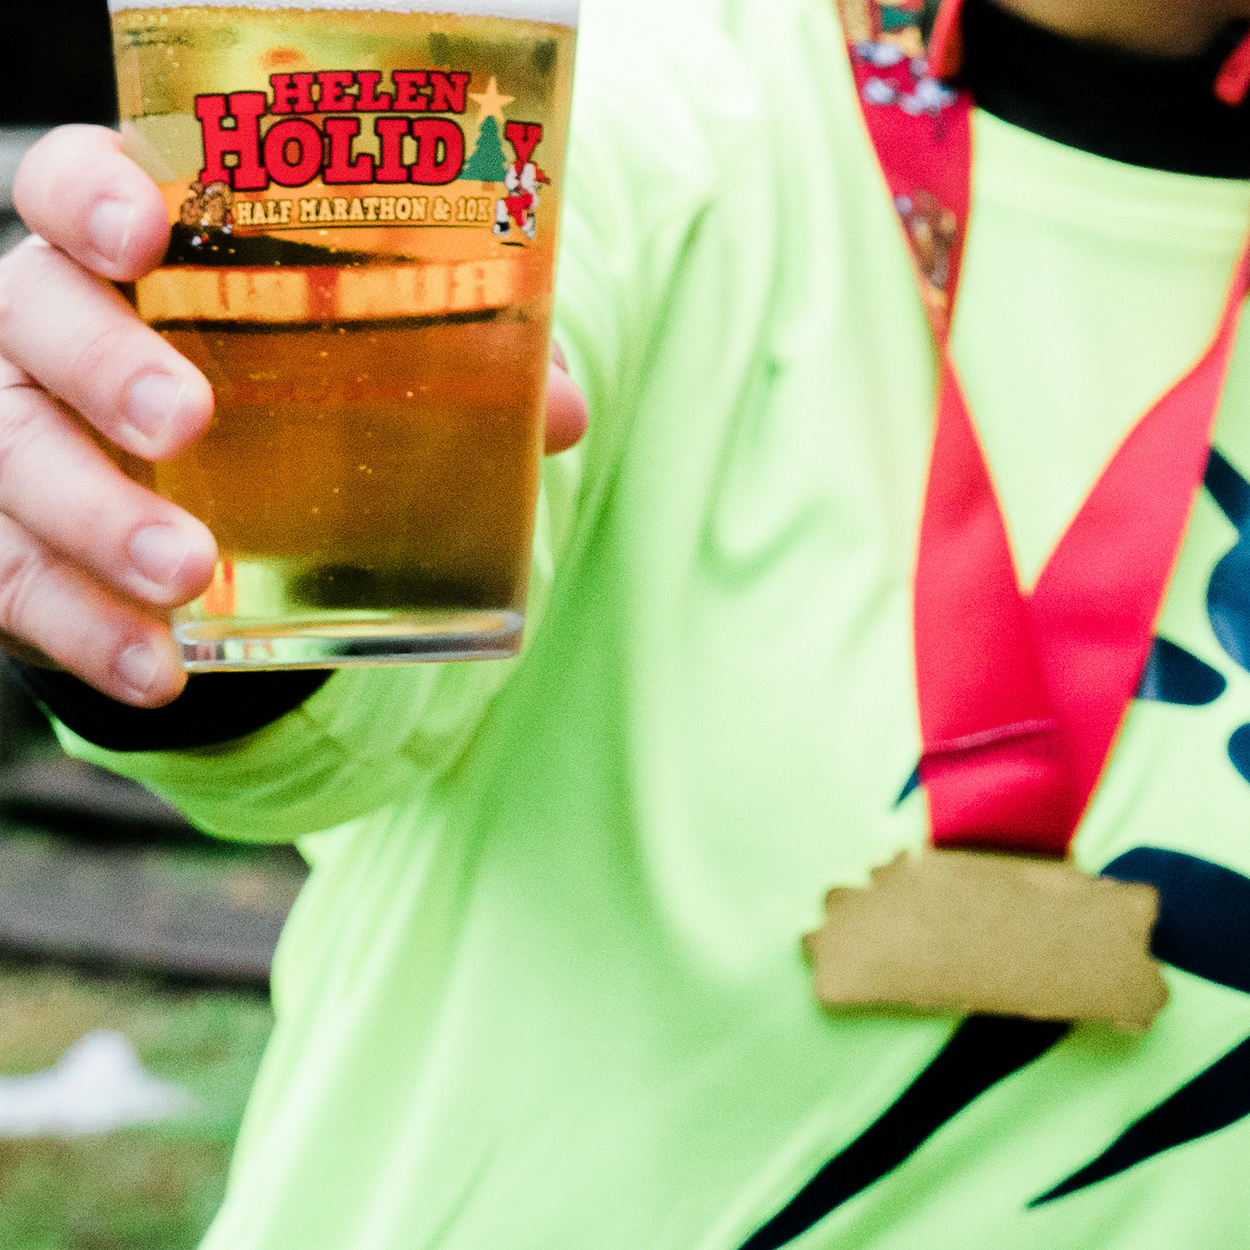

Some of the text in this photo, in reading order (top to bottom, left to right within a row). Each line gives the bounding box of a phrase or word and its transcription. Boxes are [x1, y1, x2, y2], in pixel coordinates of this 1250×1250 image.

[269, 70, 471, 114] HELEN
[237, 196, 492, 225] HALF MARATHON & 10K
